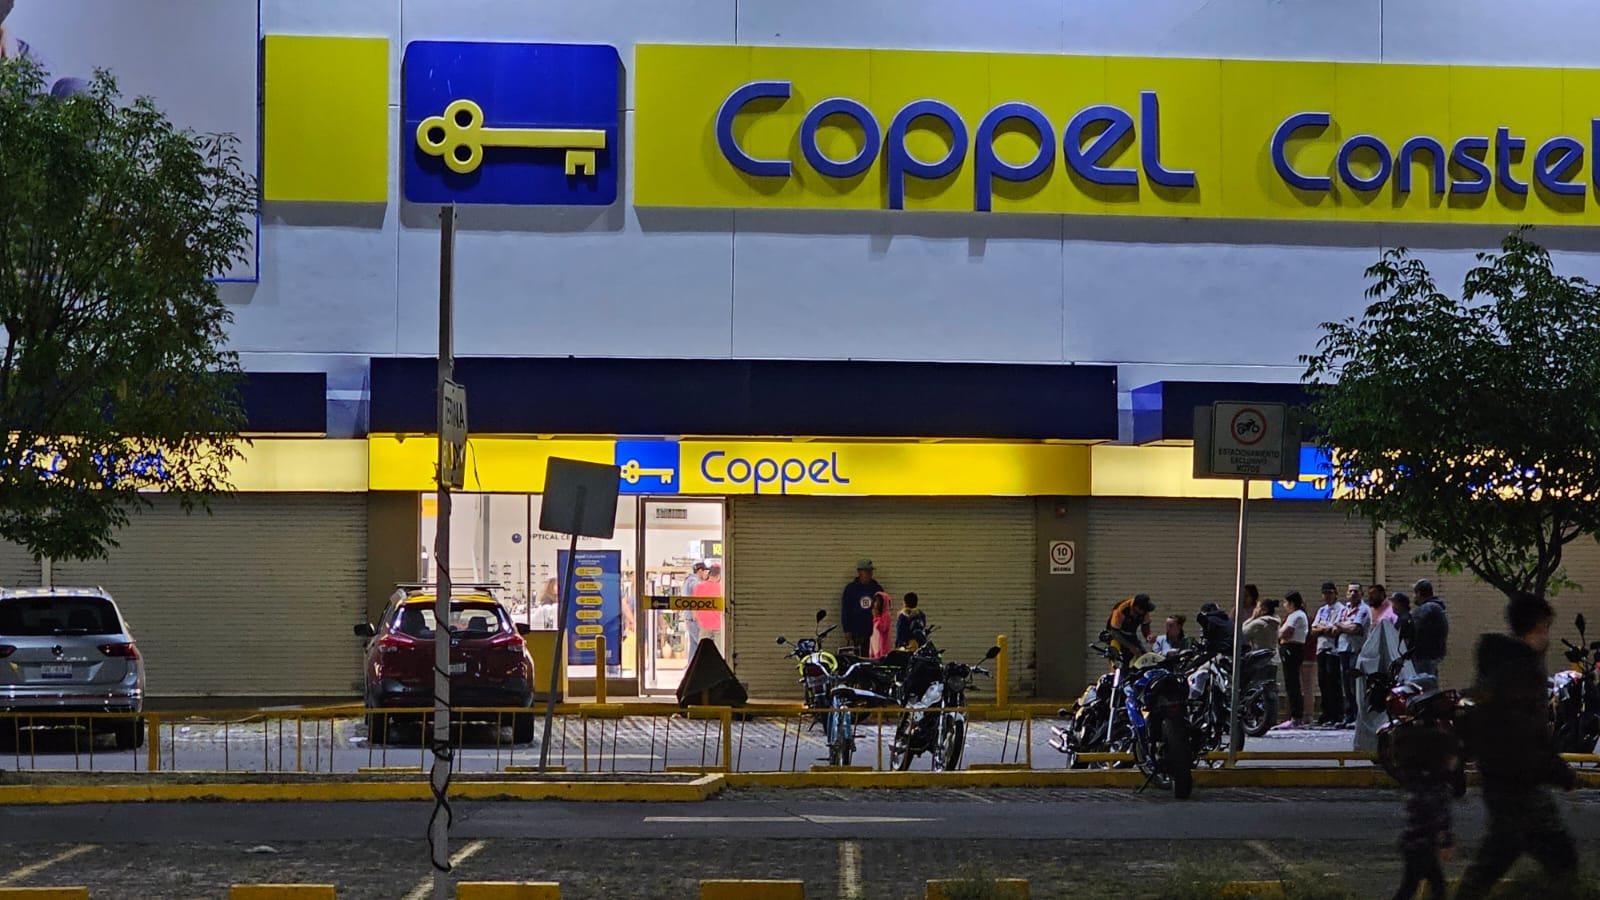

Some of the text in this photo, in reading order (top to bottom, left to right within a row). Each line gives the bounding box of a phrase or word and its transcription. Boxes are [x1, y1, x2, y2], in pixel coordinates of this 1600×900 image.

[715, 79, 1195, 212] Coppel
[701, 451, 850, 496] Coppel
[1057, 547, 1068, 557] 10
[674, 599, 717, 610] Coppel
